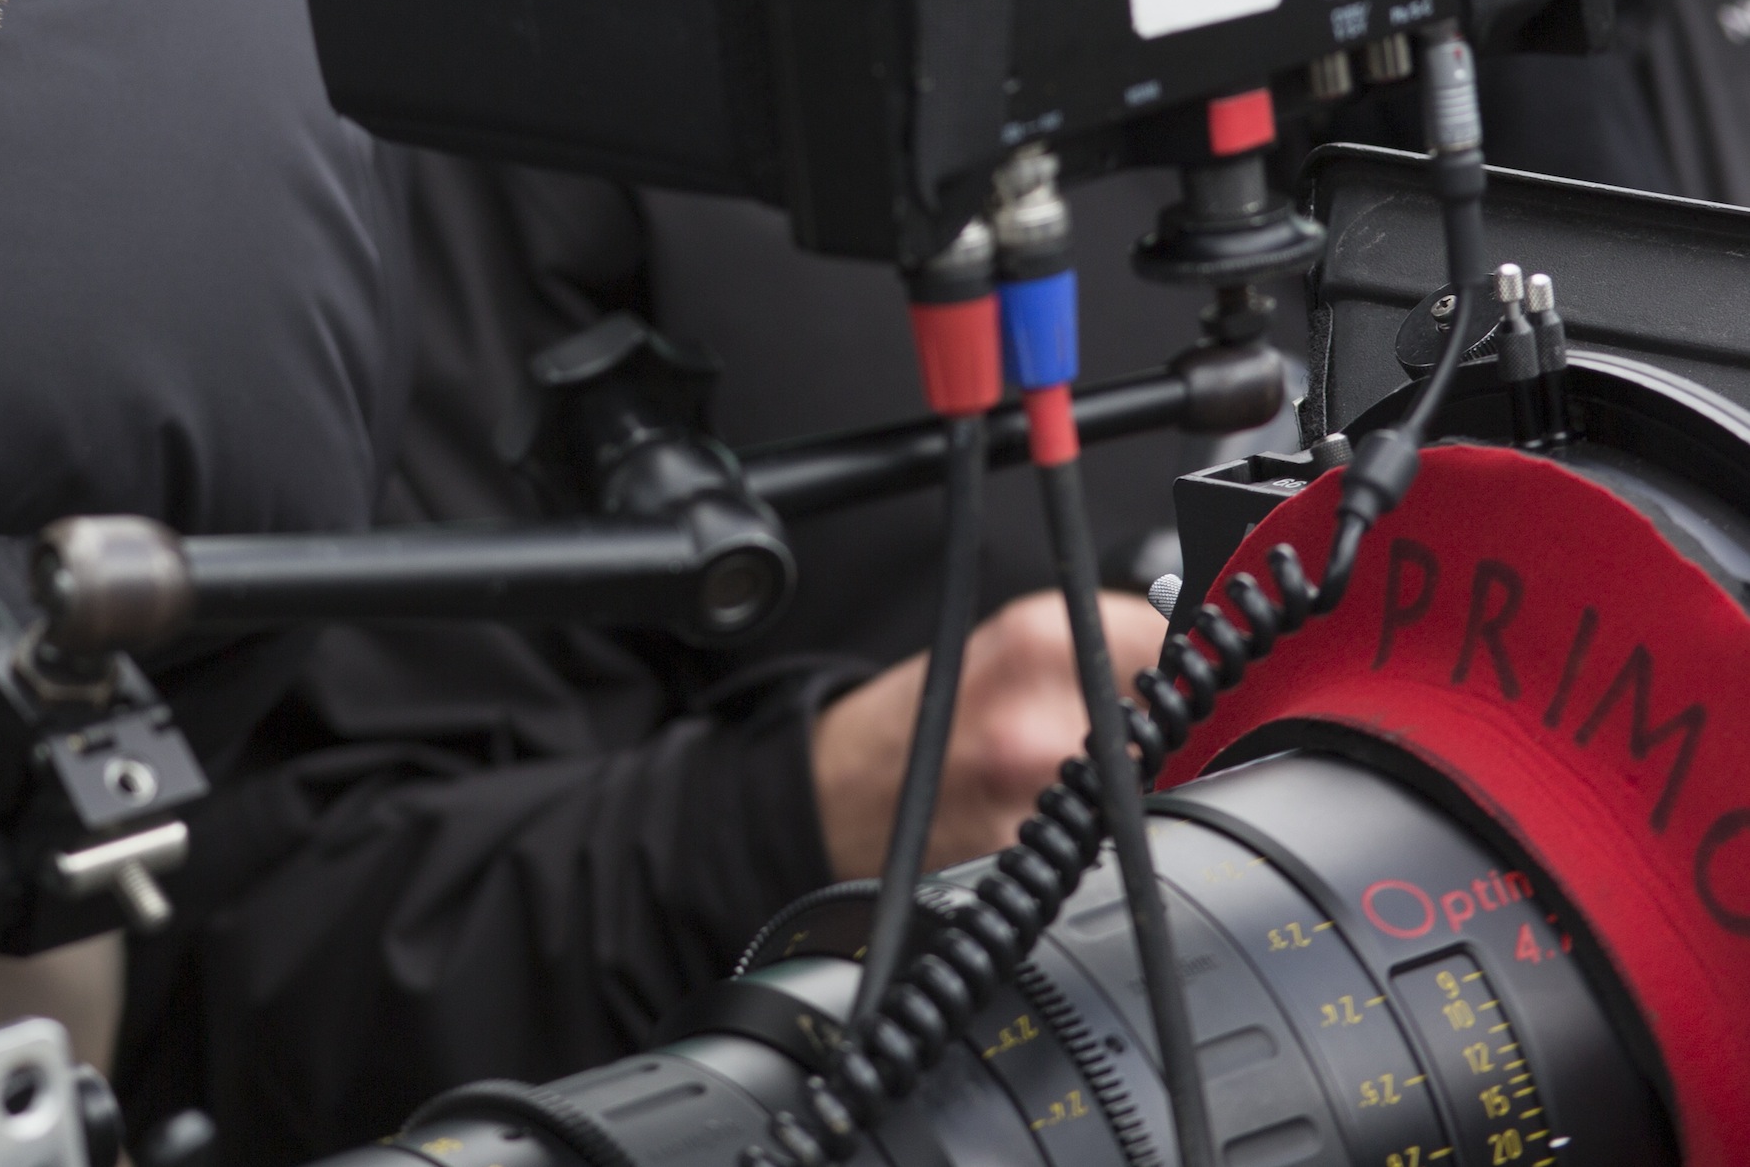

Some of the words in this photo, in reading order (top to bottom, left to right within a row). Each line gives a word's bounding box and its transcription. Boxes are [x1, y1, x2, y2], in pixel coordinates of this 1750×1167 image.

[1436, 970, 1460, 1000] 9
[1442, 999, 1476, 1031] 10
[1462, 1042, 1495, 1075] 12
[1479, 1085, 1511, 1119] 15
[1487, 1128, 1523, 1166] 20
